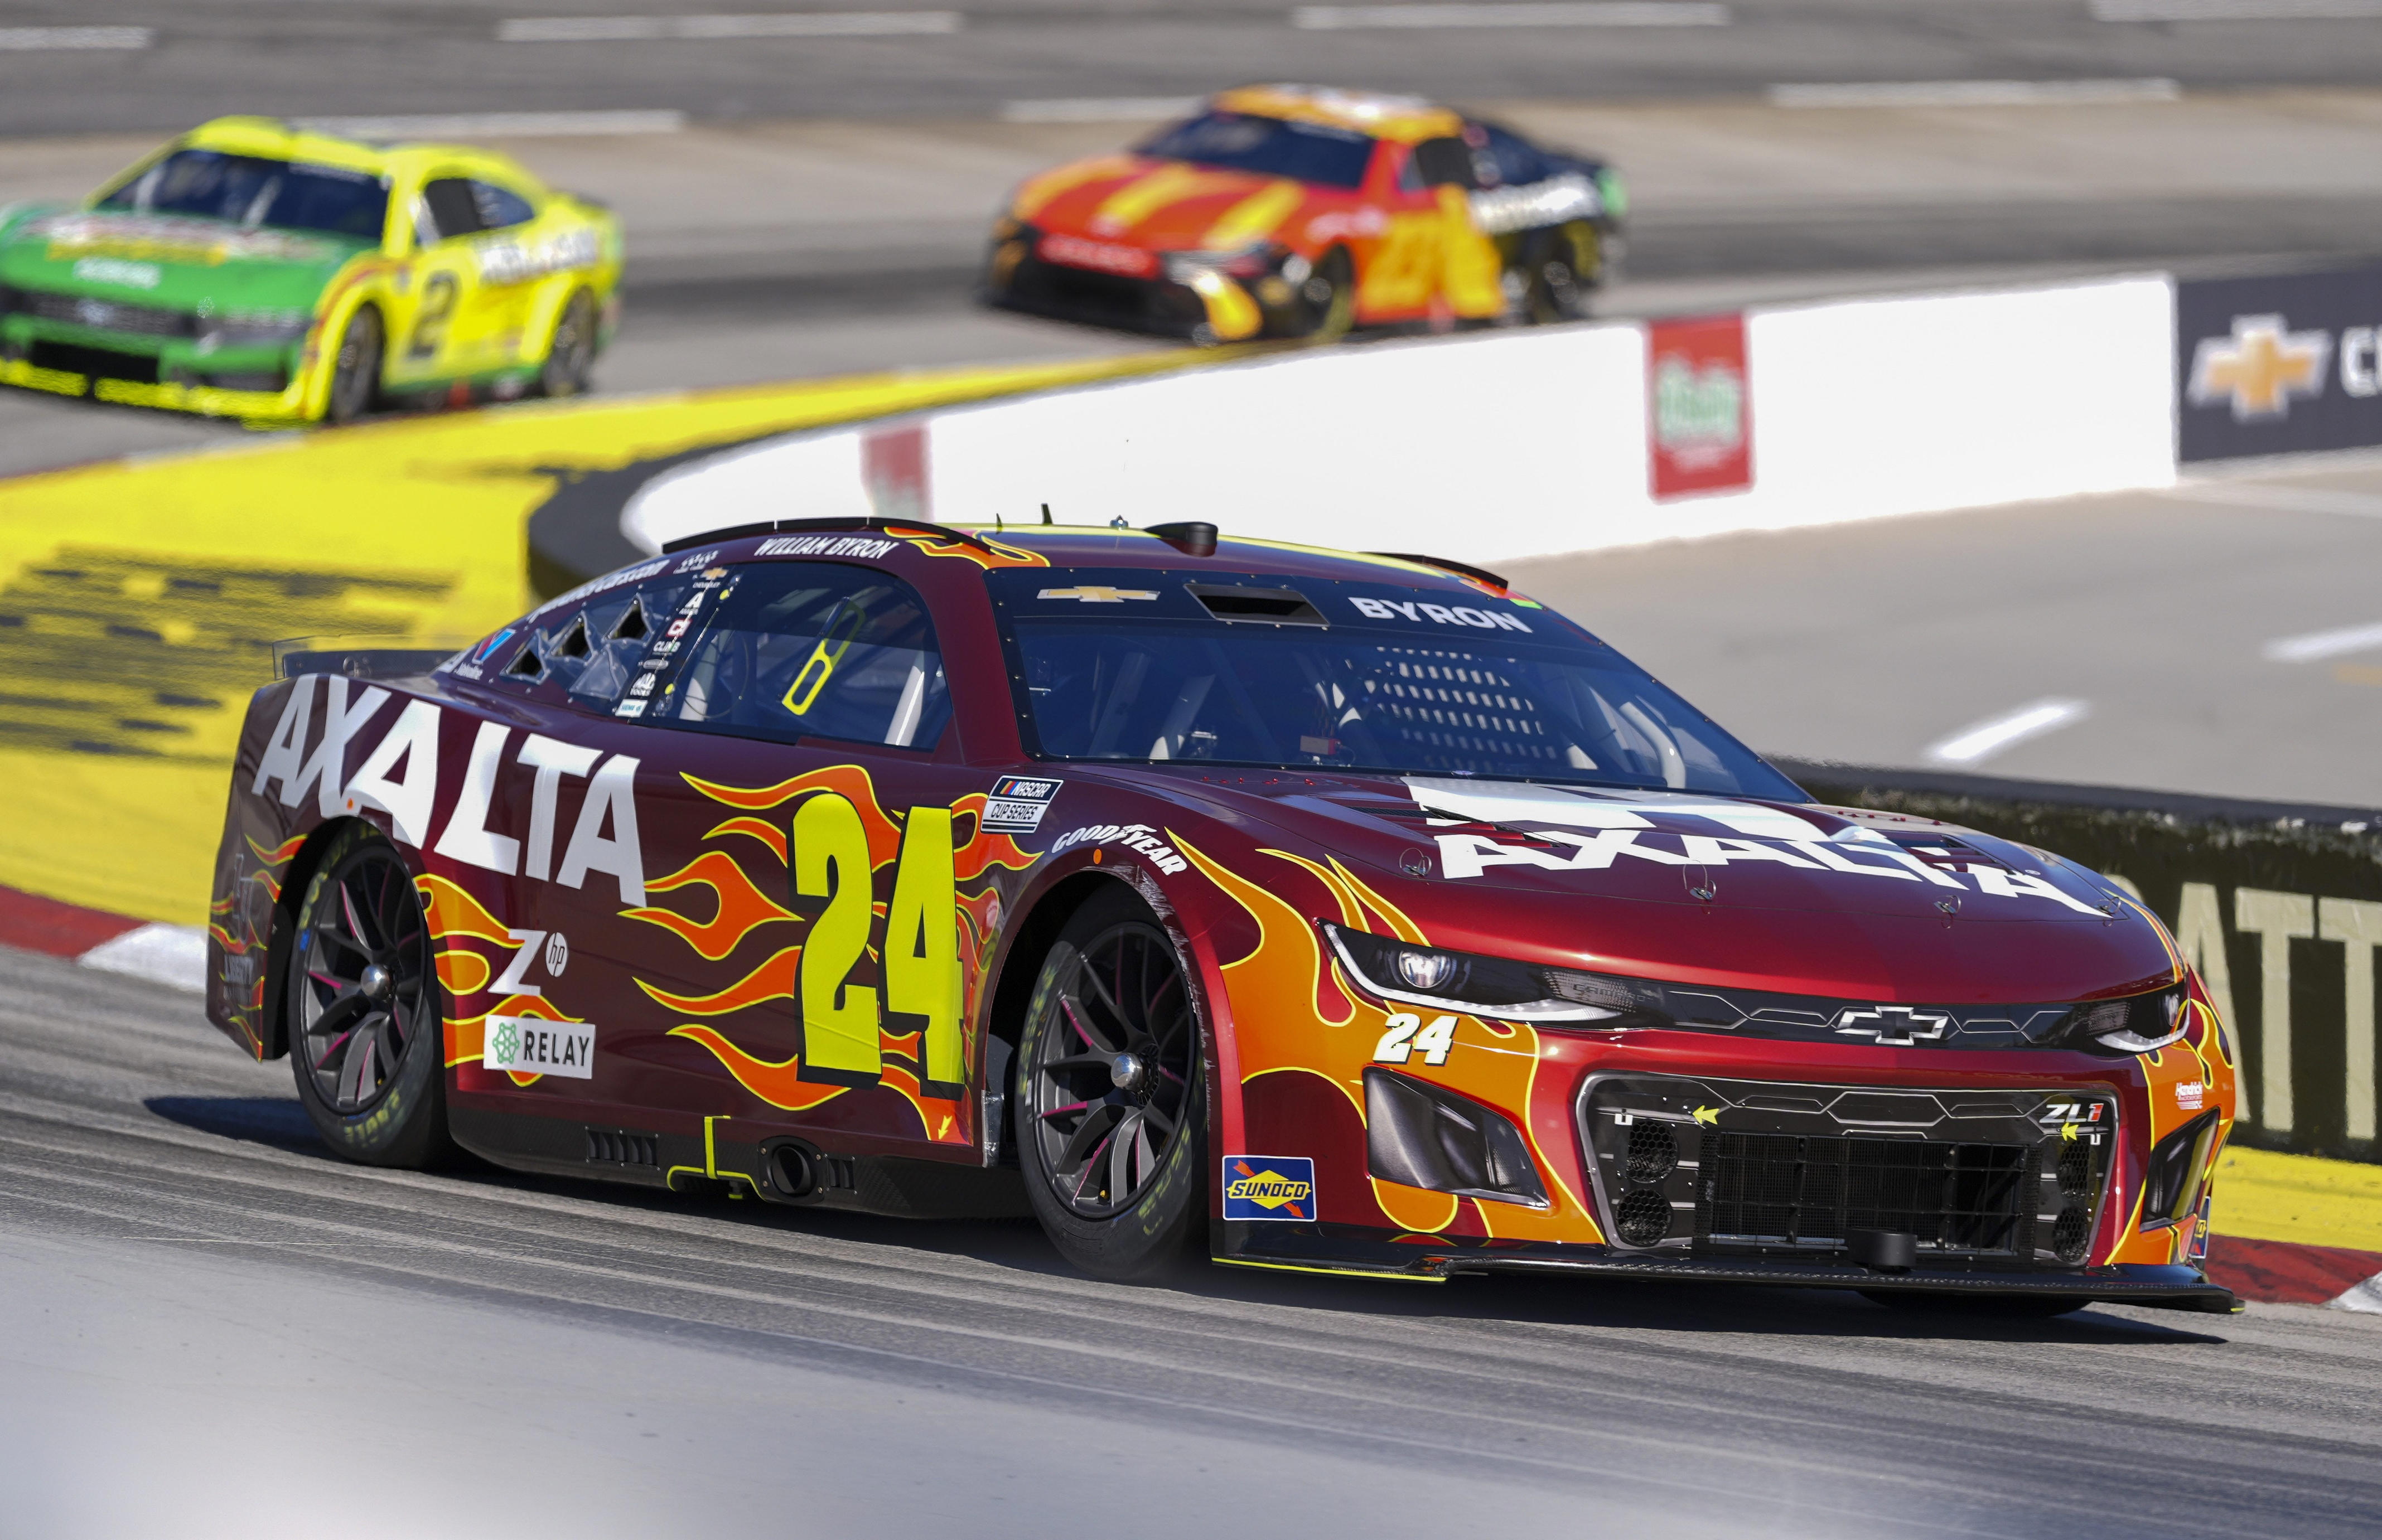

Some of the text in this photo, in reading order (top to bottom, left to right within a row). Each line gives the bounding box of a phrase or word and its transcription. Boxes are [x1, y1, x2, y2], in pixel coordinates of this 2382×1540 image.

[407, 269, 462, 361] 2
[753, 537, 899, 559] WILLIAM BYRON
[1347, 597, 1534, 633] BYRON
[252, 673, 647, 908] AXALTA
[991, 803, 1038, 820] CUP SERIES
[1011, 781, 1052, 798] NASCAR
[1051, 824, 1188, 876] GOODYEAR
[1432, 829, 2114, 919] AXALTA
[487, 928, 548, 996] Z
[789, 791, 965, 1096] 24
[2103, 873, 2382, 1141] ATT
[523, 1029, 590, 1067] RELAY
[1372, 1012, 1459, 1067] 24
[2038, 1103, 2104, 1123] ZL1
[1231, 1182, 1307, 1198] SUNOCO
